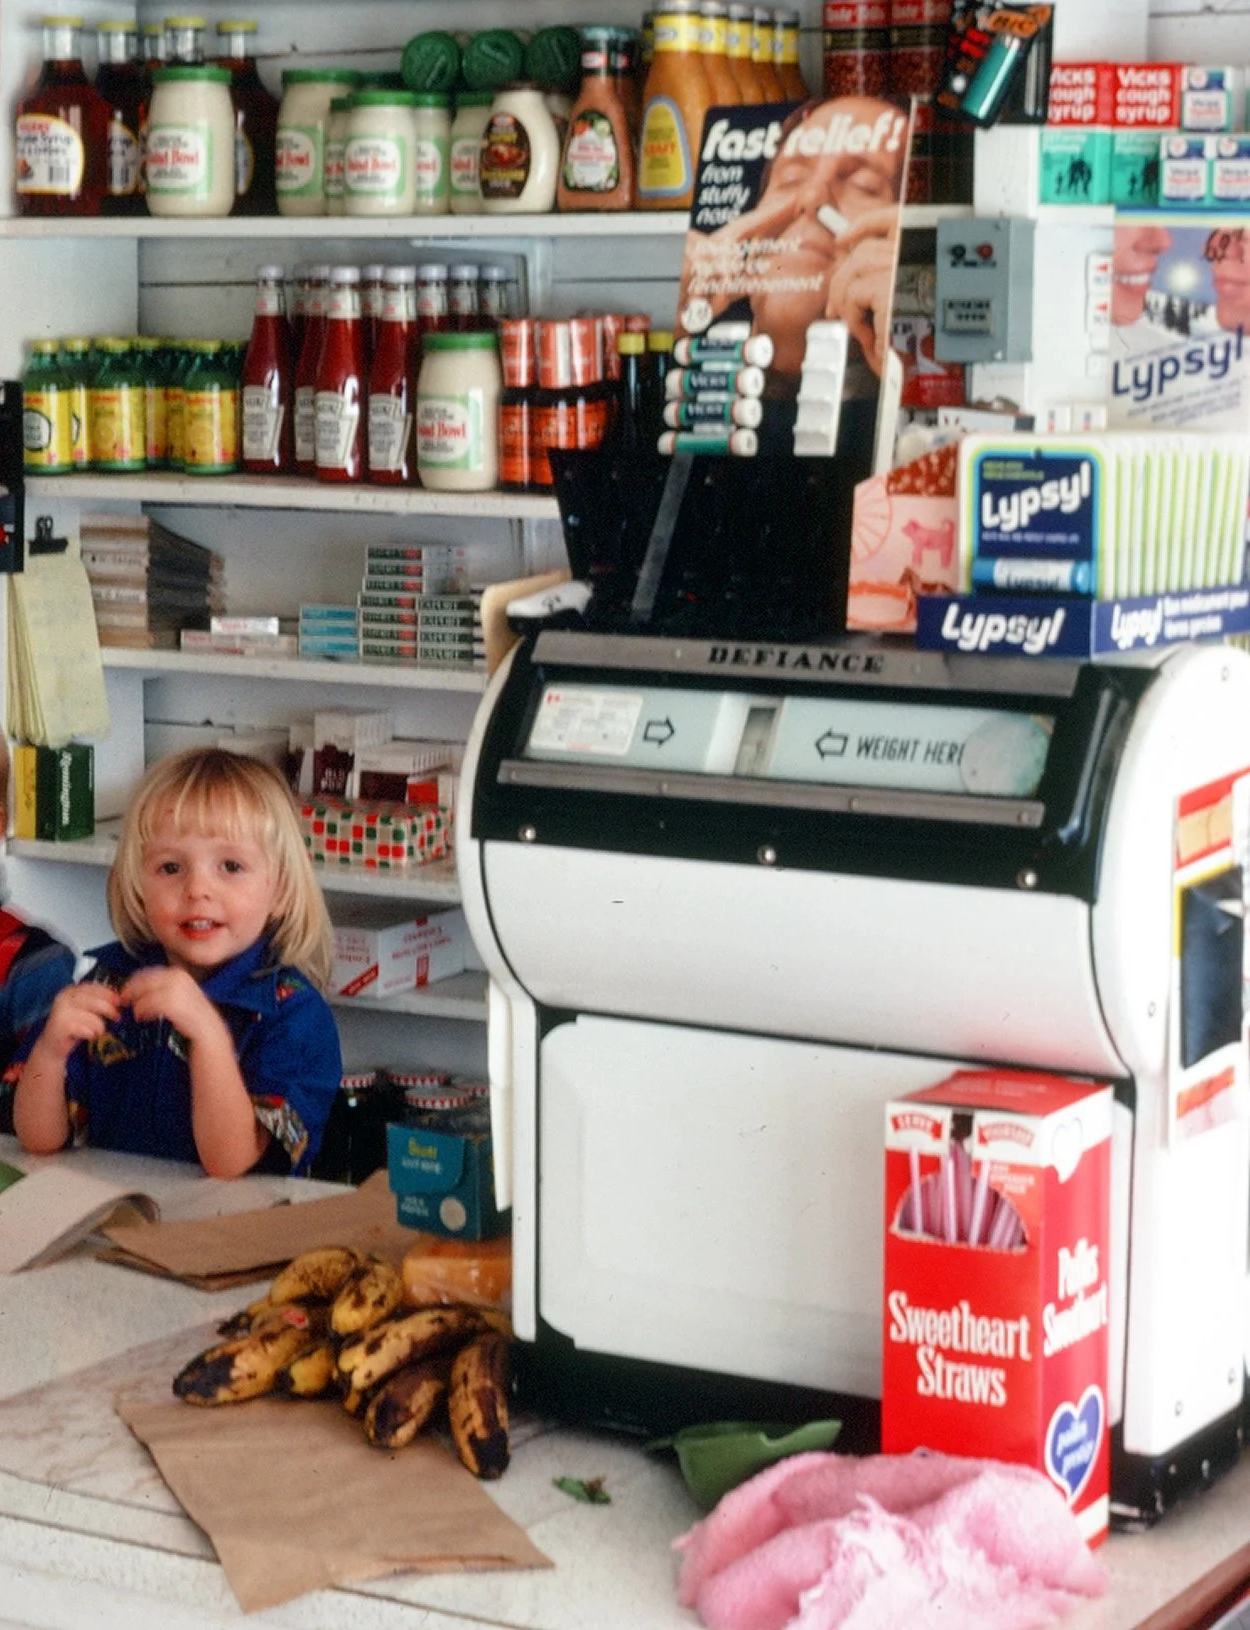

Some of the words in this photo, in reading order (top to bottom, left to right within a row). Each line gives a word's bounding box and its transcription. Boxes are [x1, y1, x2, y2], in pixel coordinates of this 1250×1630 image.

[988, 12, 1035, 36] BIC
[1051, 87, 1096, 106] ough
[1116, 88, 1170, 105] cough
[1116, 107, 1170, 124] syrup
[702, 118, 782, 162] fast
[782, 110, 907, 158] relief!
[700, 163, 744, 185] from
[1111, 323, 1245, 401] Lypsyl
[982, 461, 1091, 532] Lypsyl
[941, 603, 1067, 654] Lypsyl
[709, 645, 885, 675] DEFIANCE
[856, 735, 920, 762] WEIGHT
[889, 1290, 1032, 1362] Sweetheart
[916, 1344, 1007, 1407] Straws
